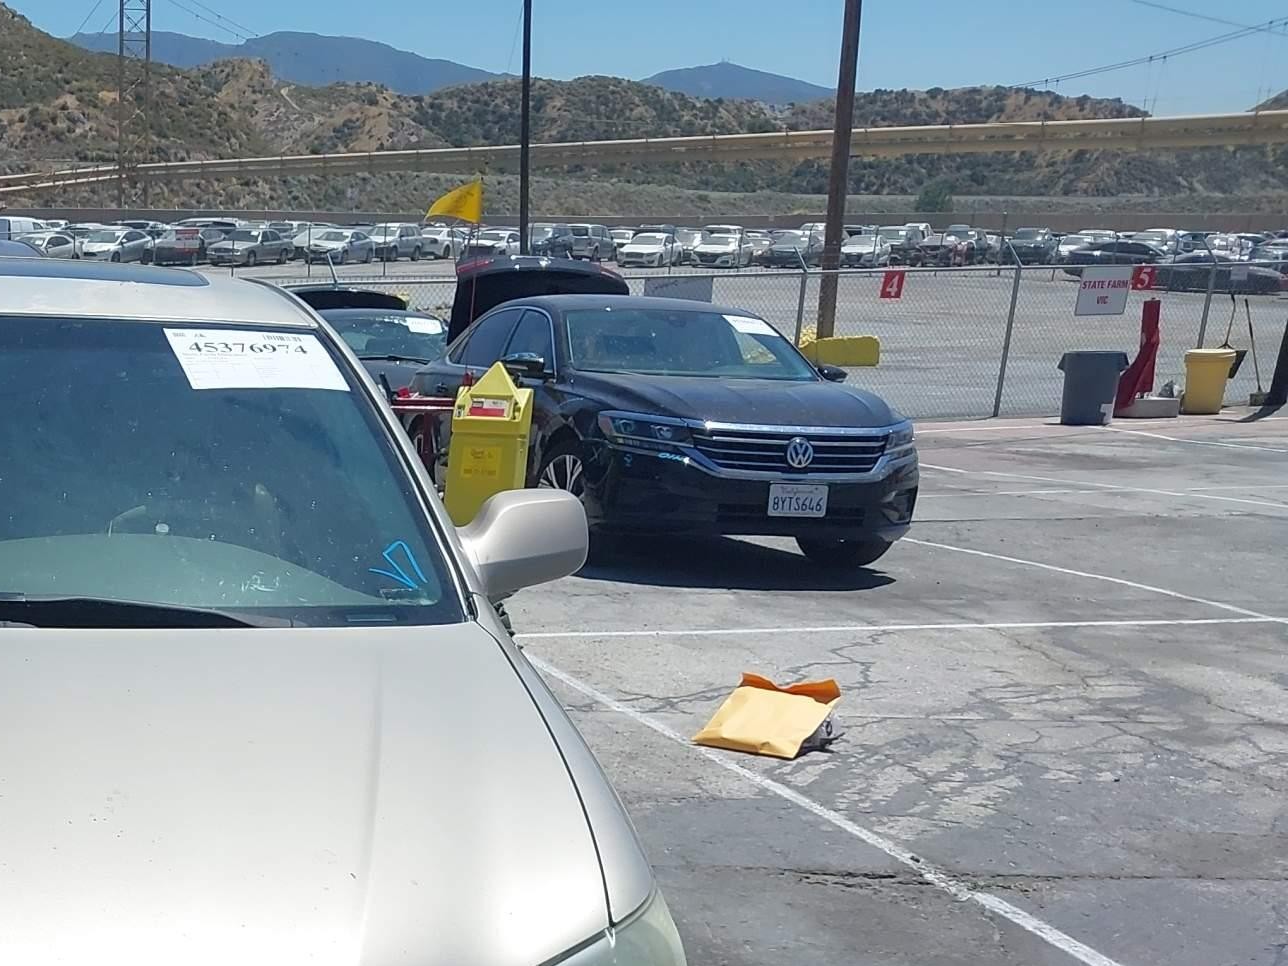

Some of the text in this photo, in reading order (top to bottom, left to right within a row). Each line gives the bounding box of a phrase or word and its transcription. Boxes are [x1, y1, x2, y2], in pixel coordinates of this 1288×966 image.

[885, 274, 899, 297] 4
[1081, 280, 1129, 290] STATE FARM
[1136, 267, 1152, 289] 5
[188, 341, 308, 355] 45376974
[772, 496, 824, 512] 8YTS646
